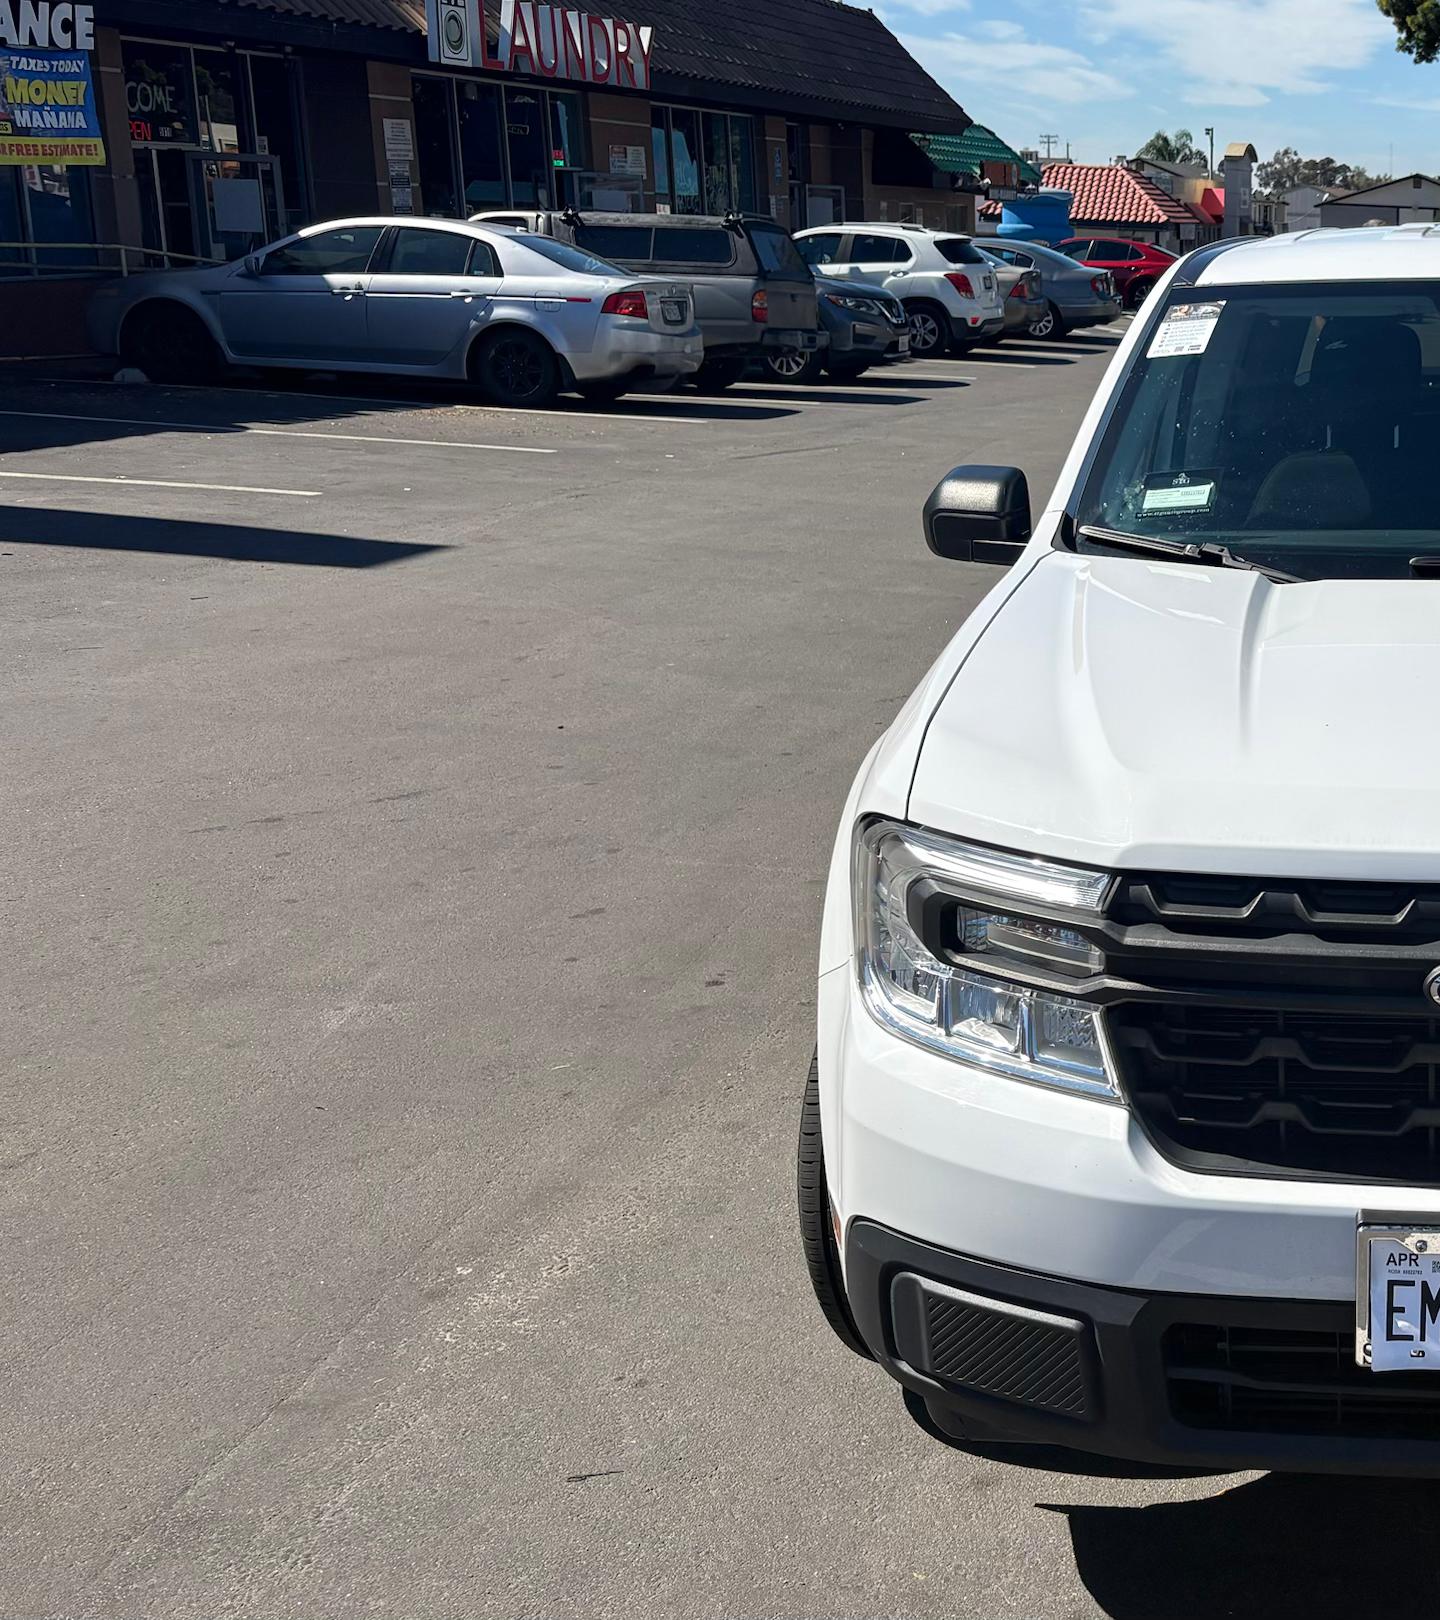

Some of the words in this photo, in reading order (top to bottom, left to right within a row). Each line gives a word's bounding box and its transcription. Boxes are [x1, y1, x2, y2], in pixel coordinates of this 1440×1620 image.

[0, 0, 95, 50] ANCE
[478, 0, 652, 89] LAUNDRY
[10, 55, 50, 72] TAXES
[50, 60, 85, 73] TODAY
[5, 76, 87, 106] MONEY
[9, 143, 39, 156] FREE
[41, 144, 99, 157] ESTIMATE!
[1386, 1252, 1420, 1267] APR
